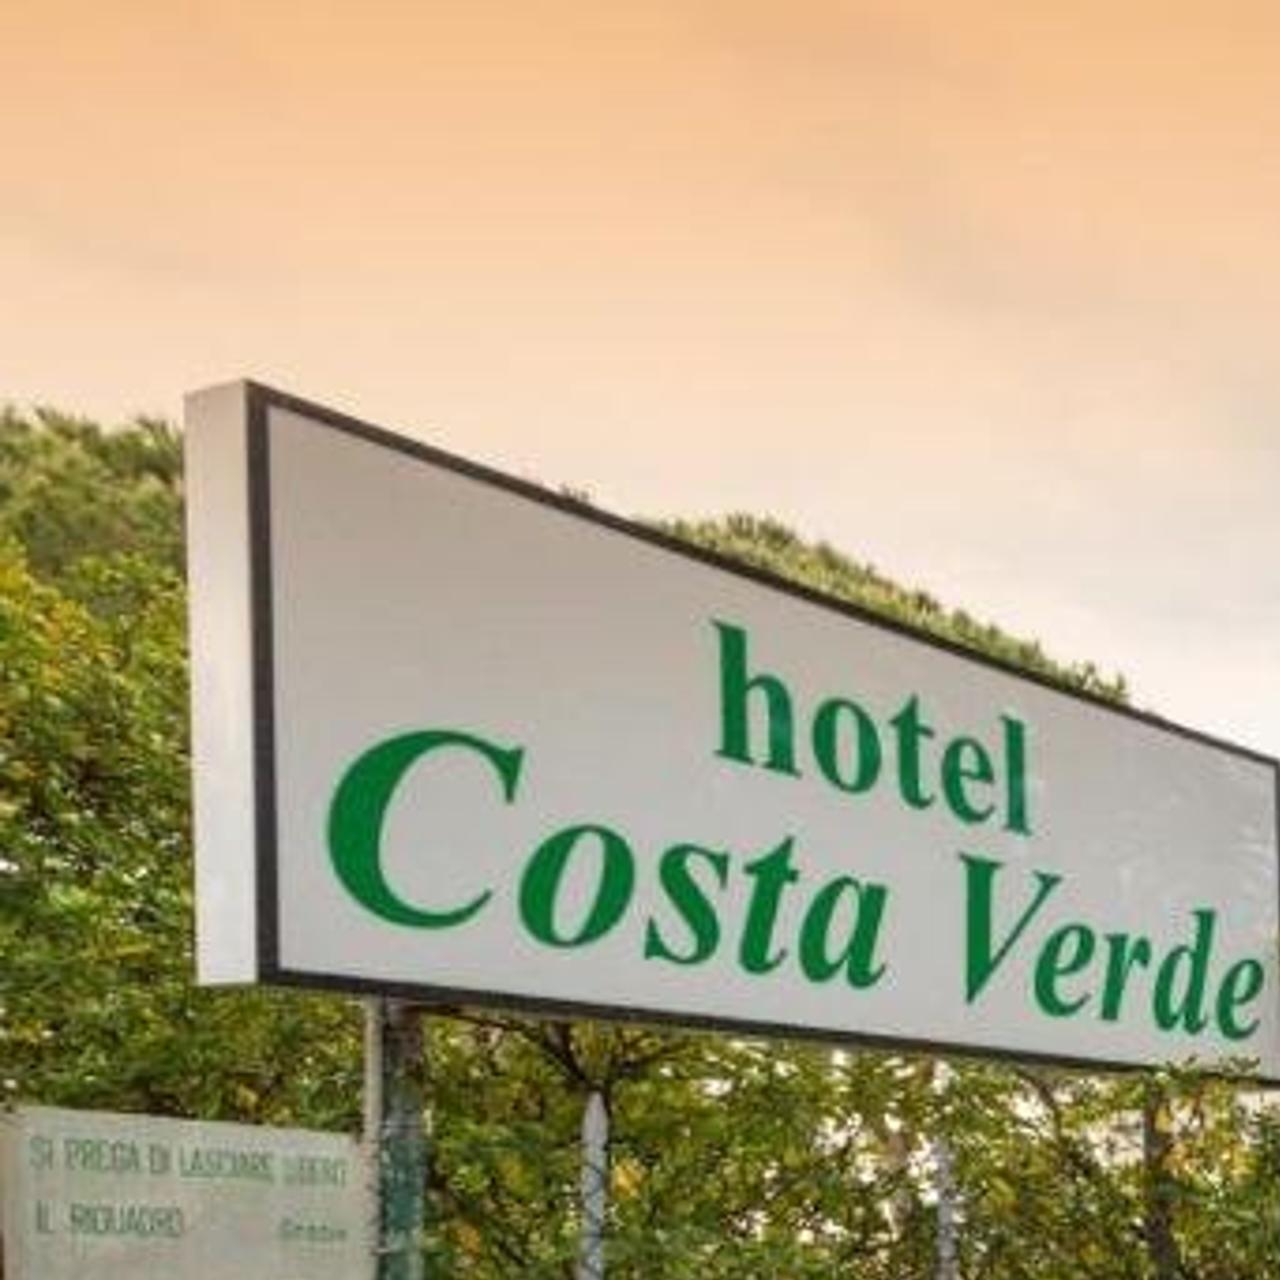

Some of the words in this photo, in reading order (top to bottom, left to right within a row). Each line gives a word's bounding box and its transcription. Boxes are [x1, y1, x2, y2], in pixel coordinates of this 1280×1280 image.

[711, 618, 1033, 838] hotel
[324, 728, 889, 991] Costa
[958, 852, 1265, 1042] Verde
[29, 1135, 53, 1170] SI
[64, 1138, 140, 1175] PREGA
[149, 1142, 170, 1175] DI
[36, 1199, 55, 1234] IL
